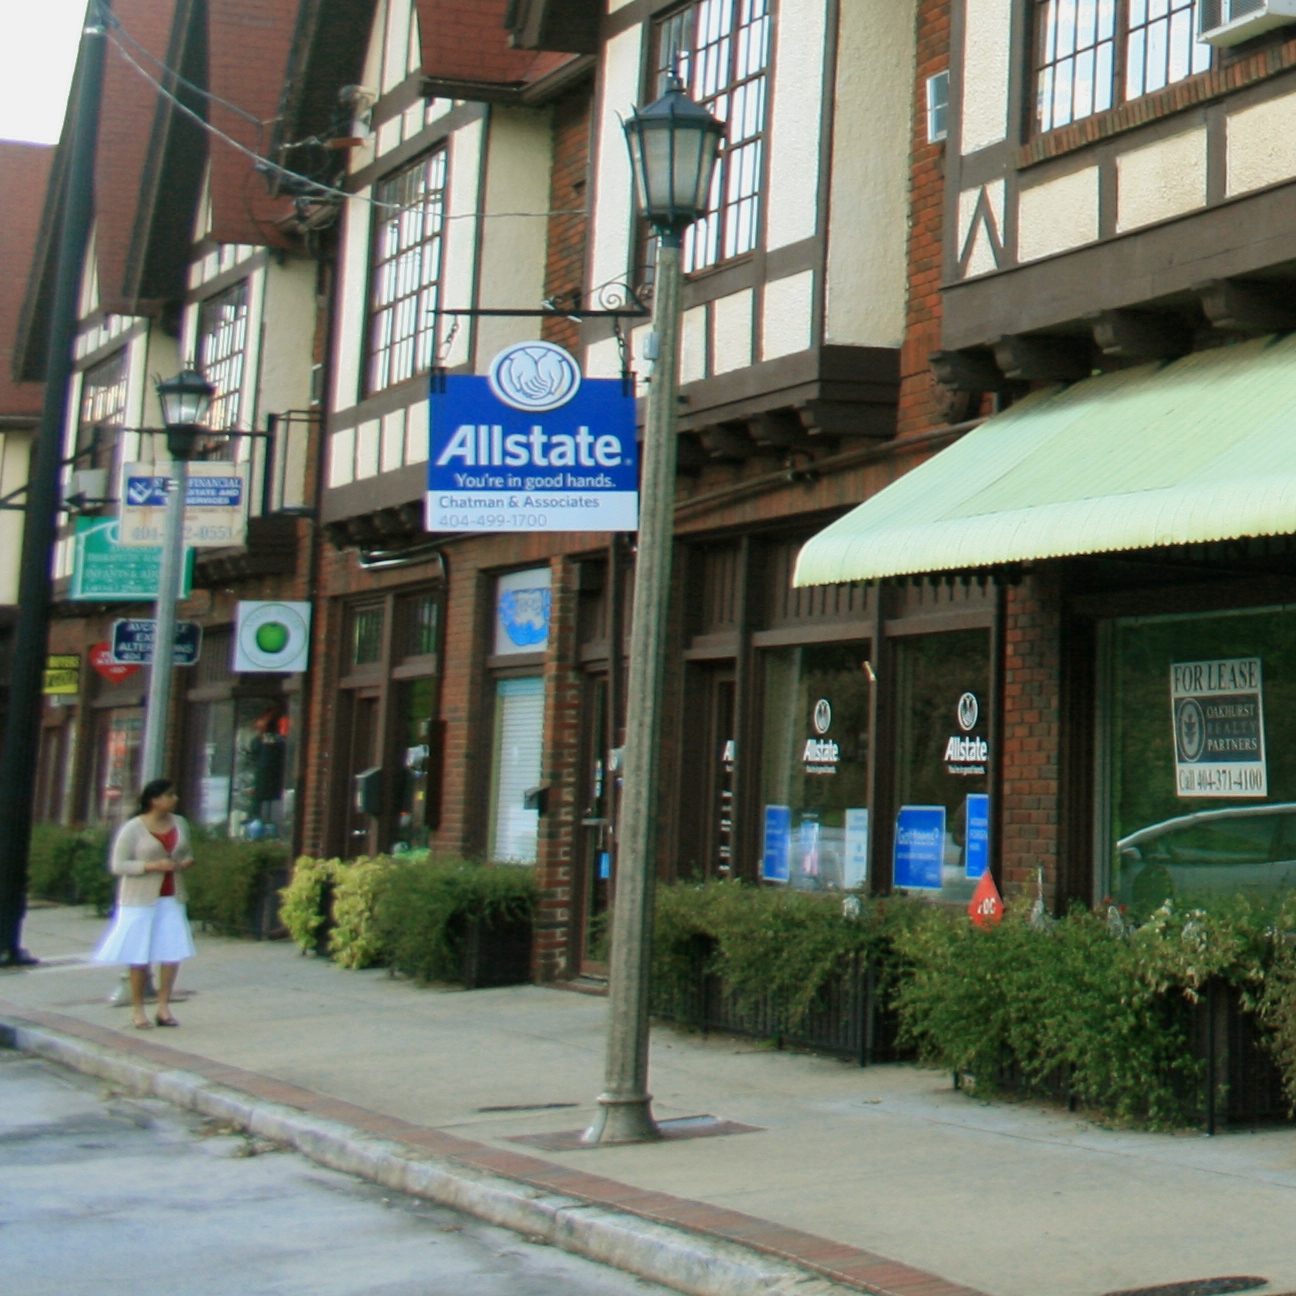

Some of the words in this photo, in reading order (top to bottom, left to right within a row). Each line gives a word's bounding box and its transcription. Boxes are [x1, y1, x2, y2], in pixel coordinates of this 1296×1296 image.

[436, 424, 622, 467] Allstate
[189, 478, 240, 487] FINANCIAL
[456, 473, 505, 488] You're
[507, 473, 522, 487] in
[524, 473, 564, 491] good
[567, 473, 616, 488] hands.
[439, 495, 505, 509] Chatman
[509, 495, 520, 508] &
[524, 495, 600, 509] Associates
[439, 514, 548, 528] 404-499-1700
[1174, 664, 1203, 692] FOR
[1208, 661, 1258, 691] LEASE
[1206, 705, 1256, 718] OAKHURST
[803, 738, 840, 762] Allstate
[944, 736, 988, 761] Allstate
[1207, 737, 1258, 752] PARTNERS
[1179, 769, 1196, 791] Call
[1198, 768, 1262, 791] 404-371-4100
